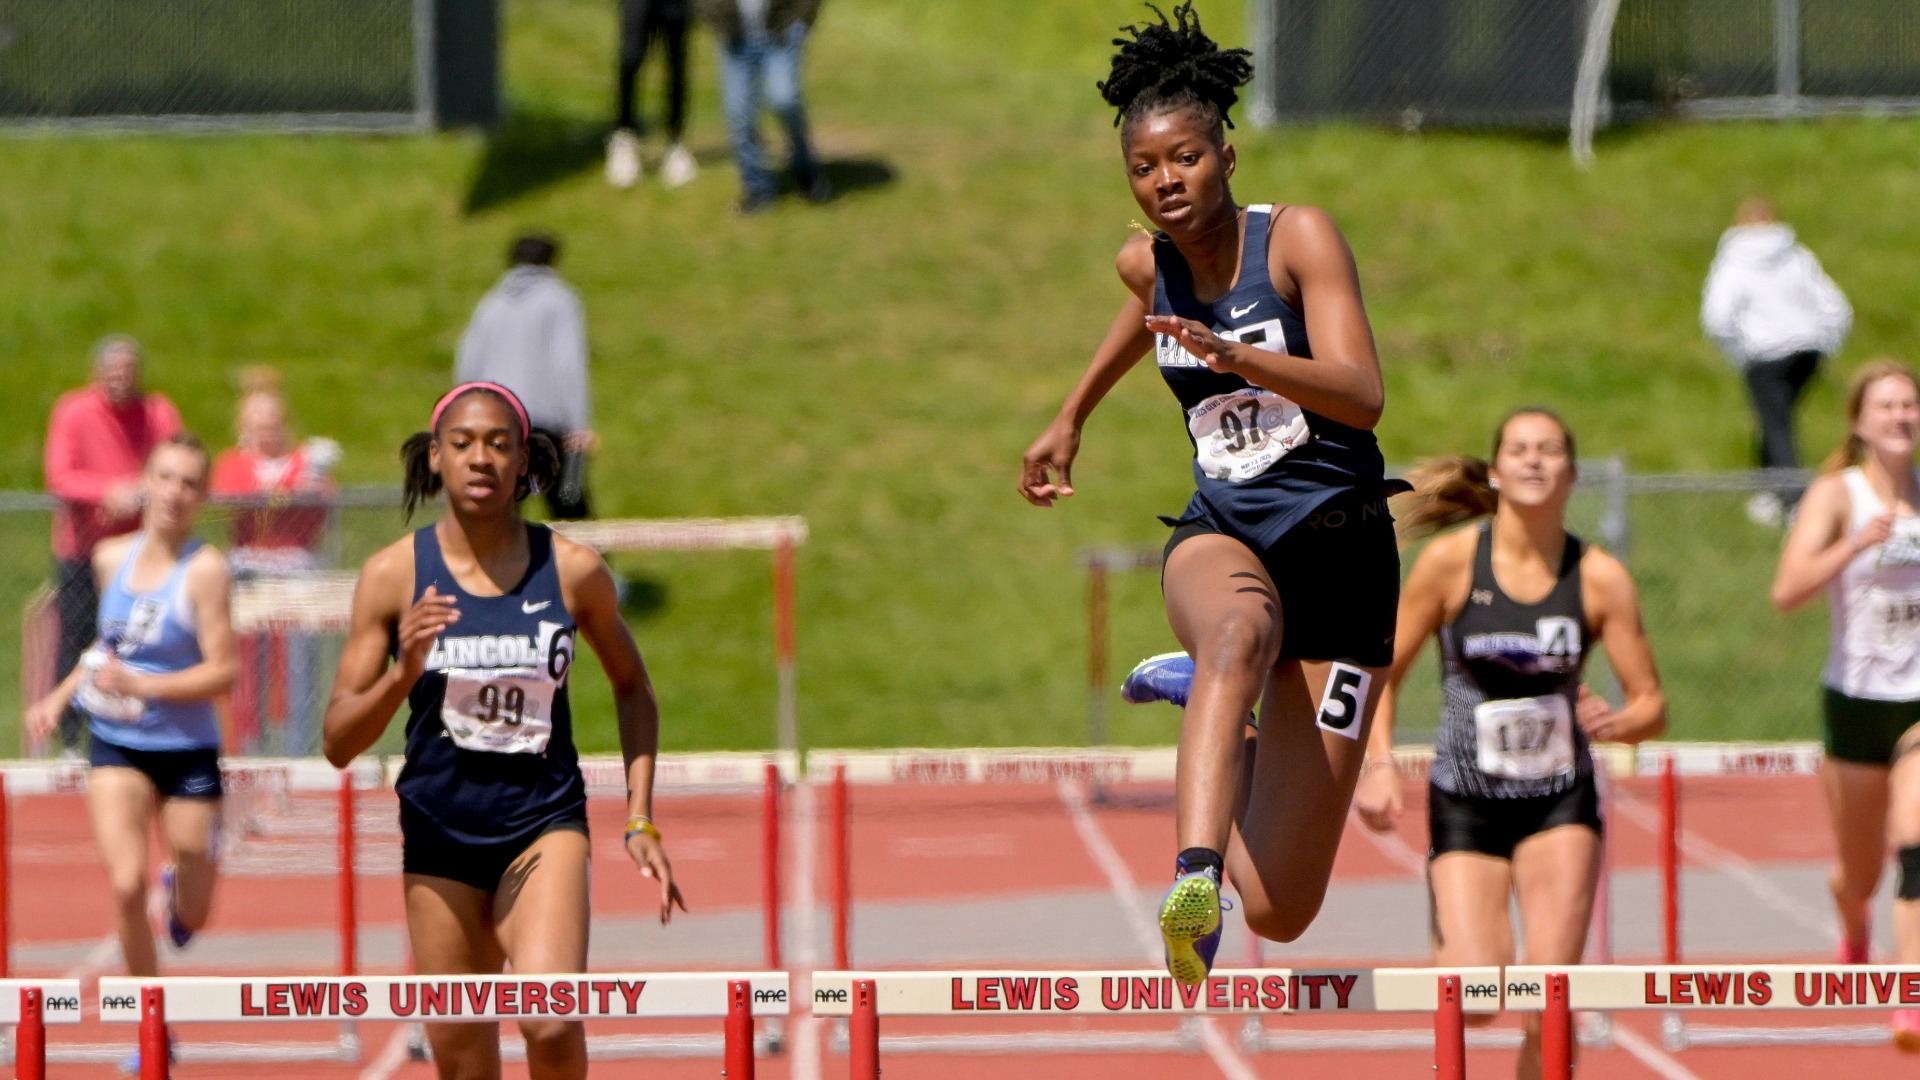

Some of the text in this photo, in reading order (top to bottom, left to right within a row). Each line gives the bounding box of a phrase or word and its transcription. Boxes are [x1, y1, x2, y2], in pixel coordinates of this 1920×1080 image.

[1219, 398, 1261, 453] 97
[425, 634, 541, 669] LINCOL
[547, 628, 573, 681] 6
[1543, 624, 1571, 657] 4
[477, 684, 525, 725] 99
[1320, 668, 1362, 730] 5
[241, 981, 647, 1017] LEWIS UNIVERSITY
[951, 975, 1358, 1010] LEWIS UNIVERSITY
[1644, 972, 1773, 1006] LEWIS
